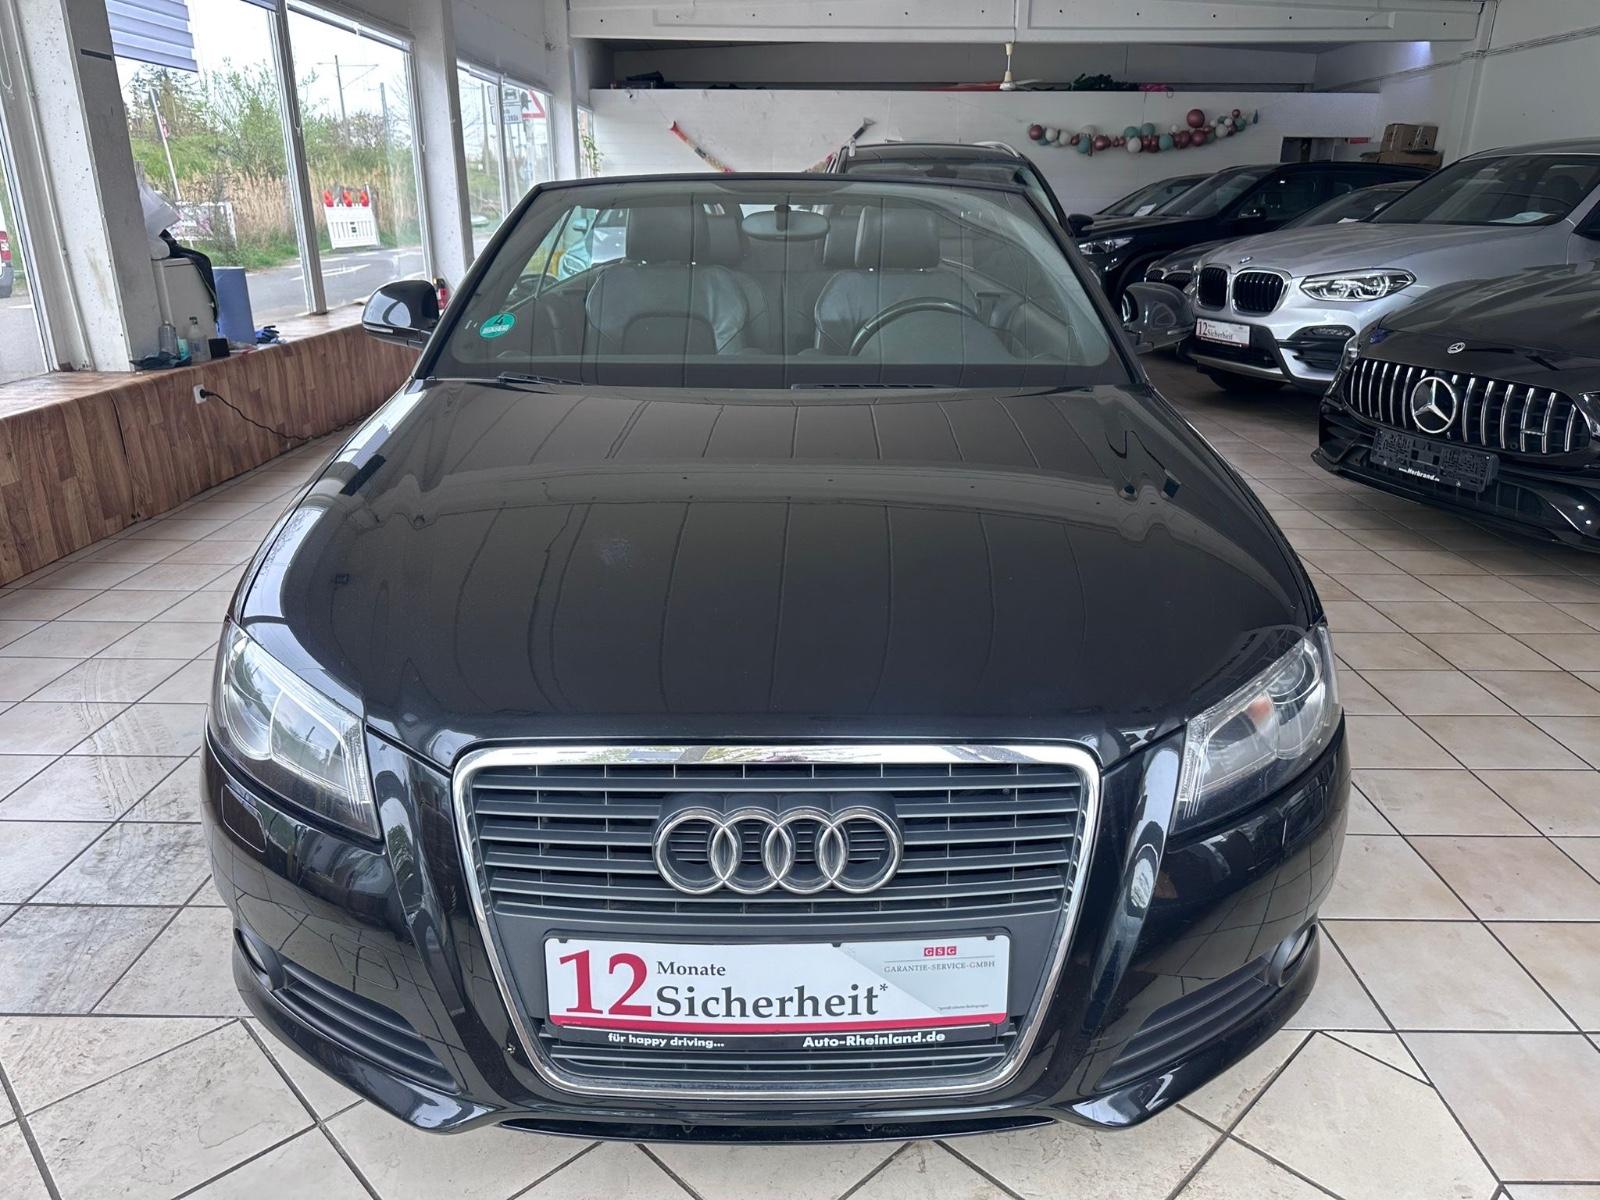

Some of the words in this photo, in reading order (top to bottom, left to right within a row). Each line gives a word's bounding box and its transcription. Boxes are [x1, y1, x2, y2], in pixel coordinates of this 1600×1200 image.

[1198, 321, 1208, 336] 12
[924, 946, 957, 957] GSG
[656, 960, 727, 977] Monate
[883, 960, 996, 973] GARANTIE-SERVICE-GMBH
[559, 949, 652, 1017] 12
[608, 1032, 626, 1042] für
[628, 1034, 667, 1047] happy
[670, 1037, 725, 1049] driving...
[802, 1030, 946, 1048] Auto-Rheinland.de
